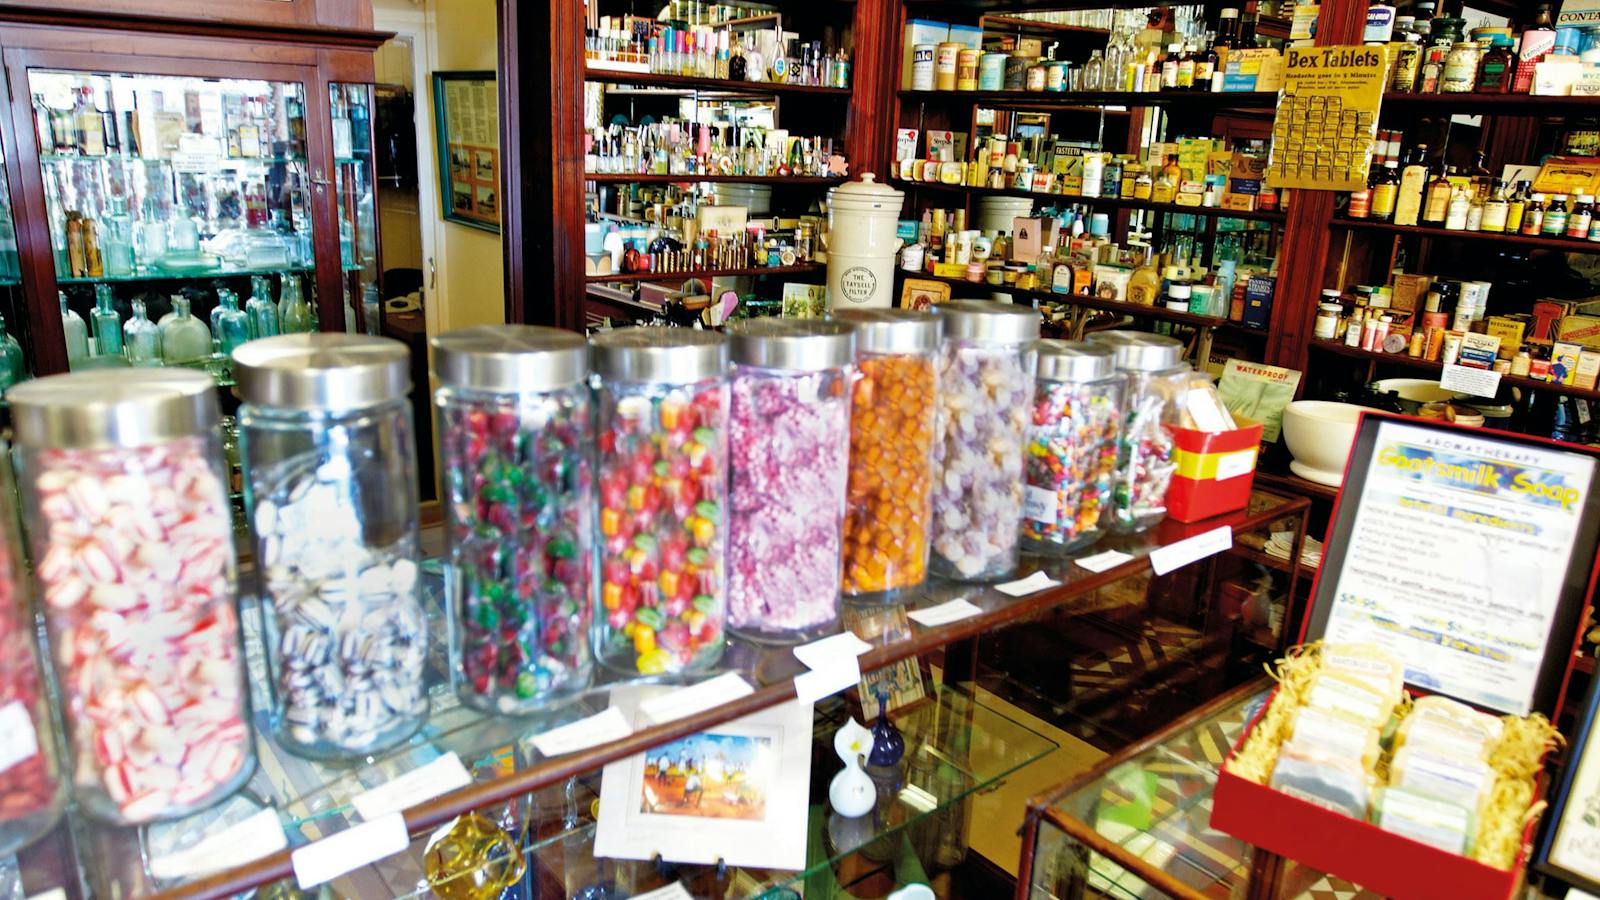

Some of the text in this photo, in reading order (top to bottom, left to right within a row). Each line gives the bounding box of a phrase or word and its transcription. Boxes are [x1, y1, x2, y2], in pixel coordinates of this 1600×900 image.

[1288, 49, 1379, 68] Bex Tablets
[1236, 365, 1289, 380] WATERPROOF
[1425, 438, 1540, 464] AROMATHERAPY
[1377, 447, 1501, 489] Goatsmilk
[1511, 472, 1579, 509] Soap
